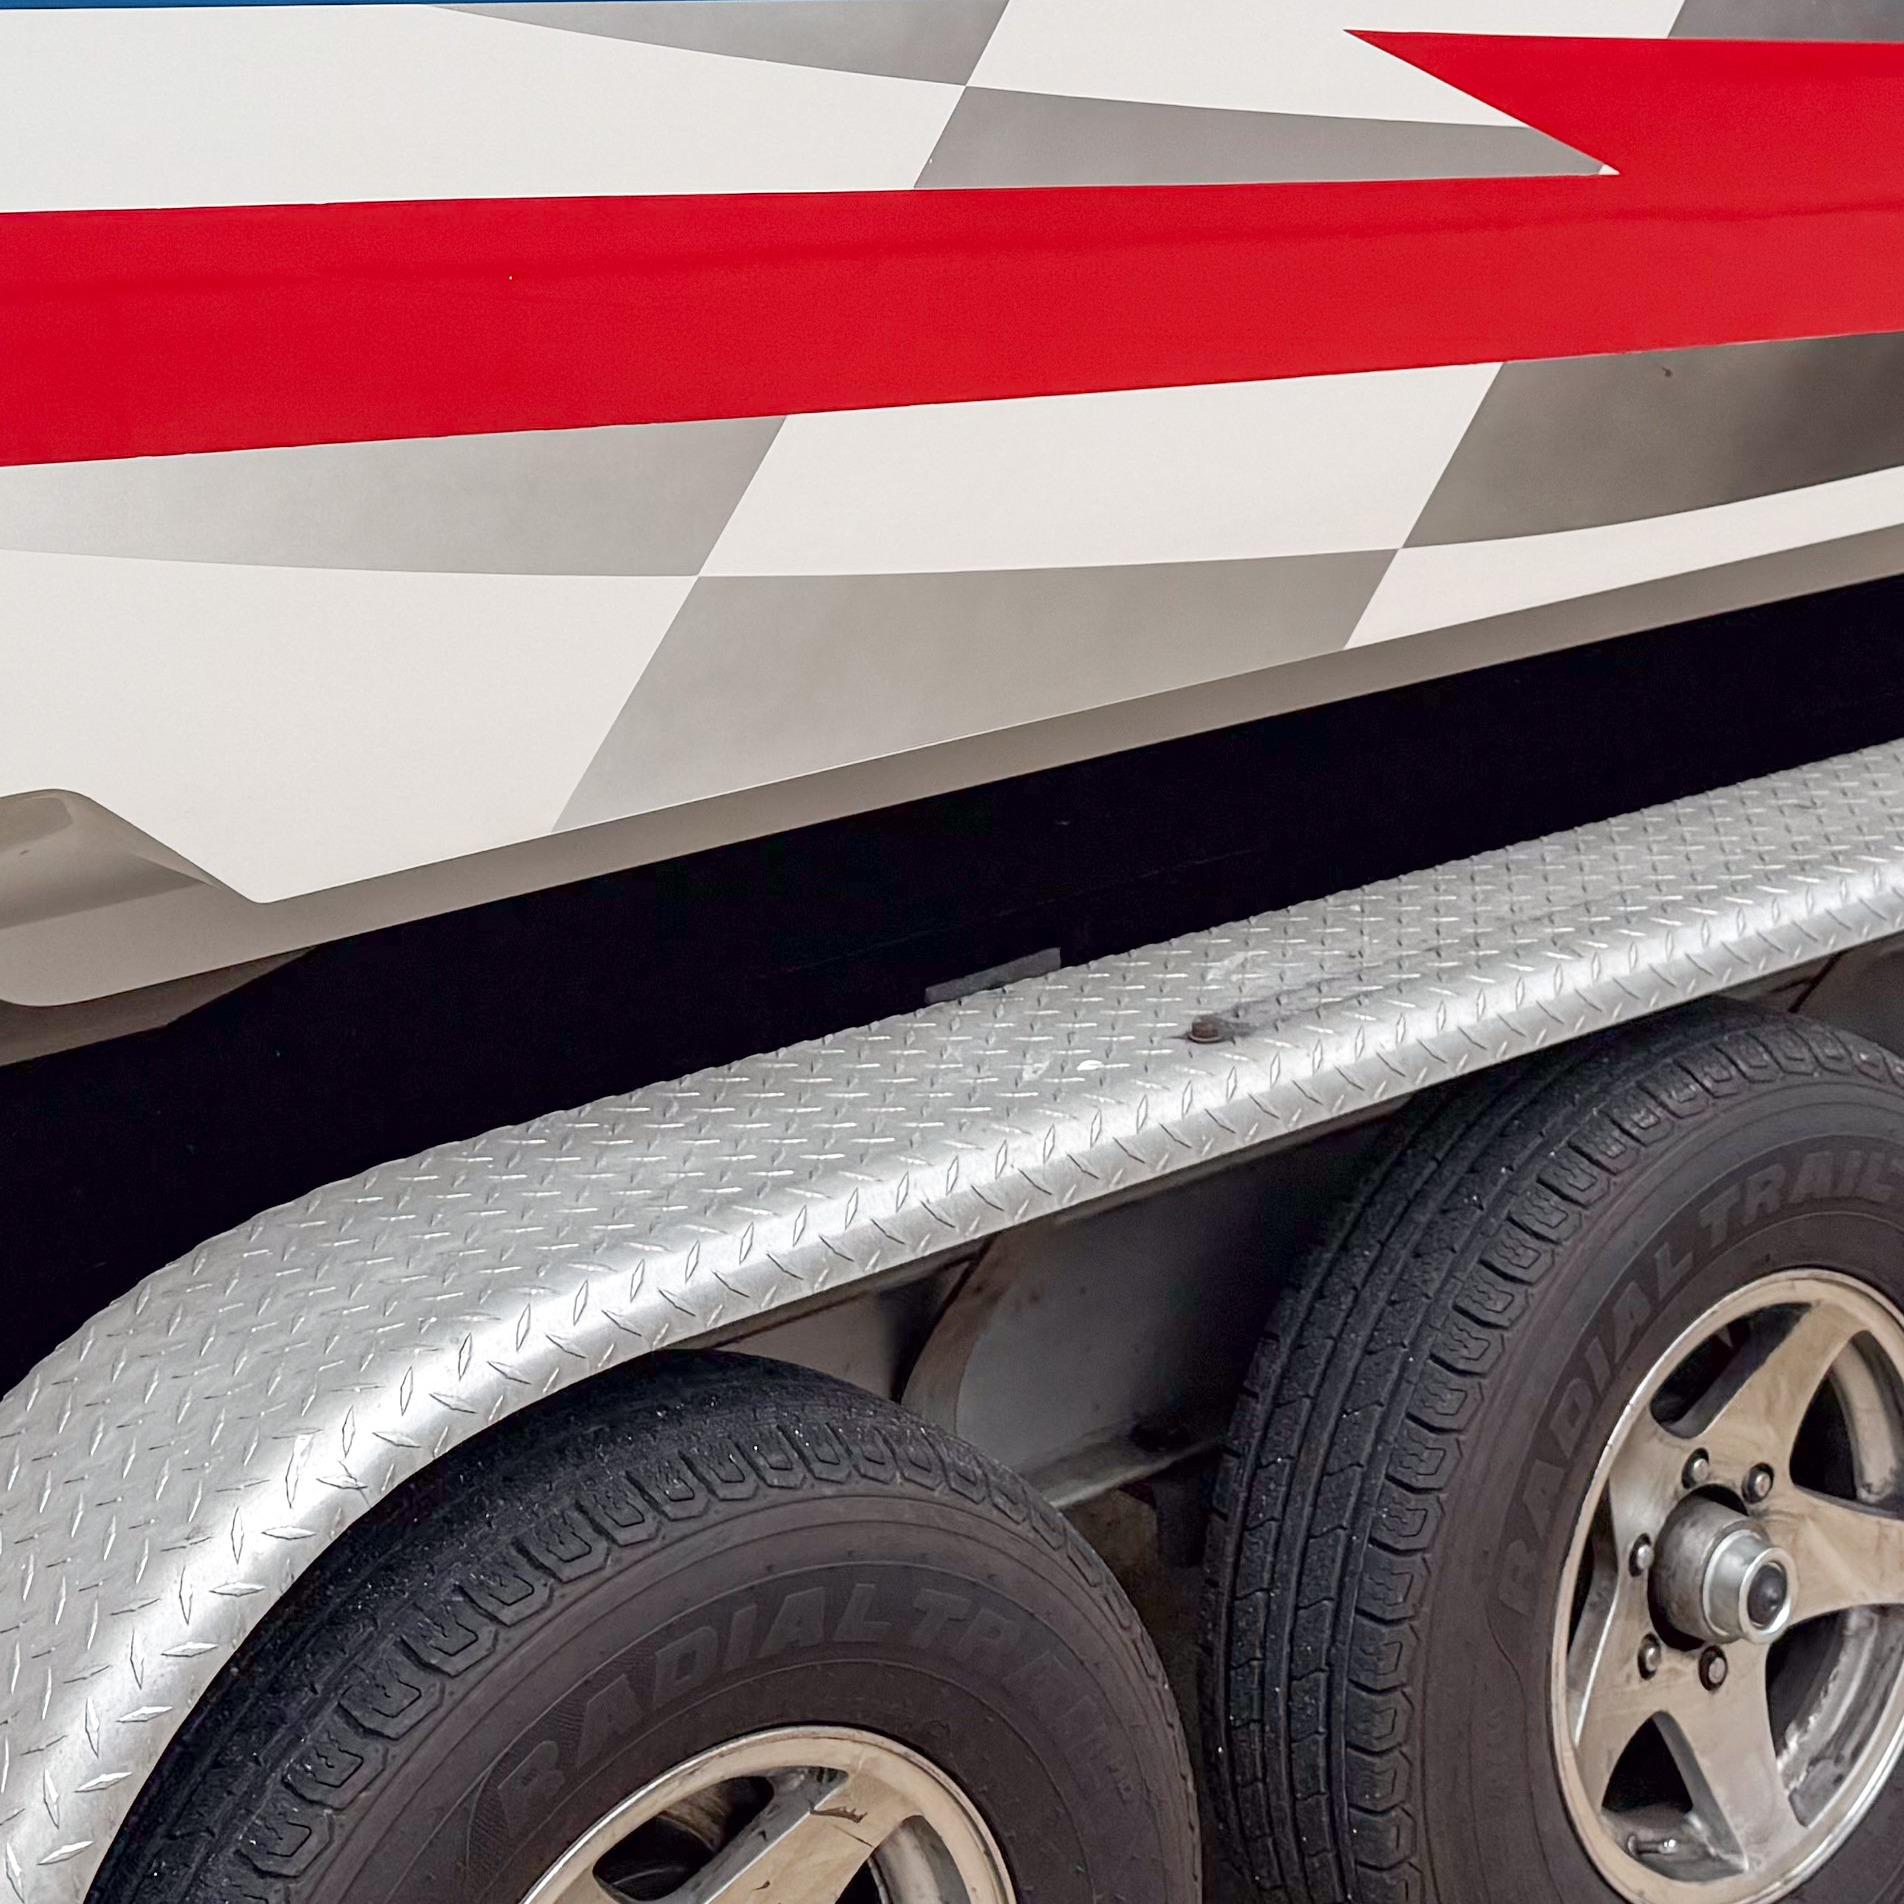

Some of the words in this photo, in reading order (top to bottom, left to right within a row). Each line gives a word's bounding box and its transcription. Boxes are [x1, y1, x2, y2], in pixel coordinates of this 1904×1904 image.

[1499, 1246, 1694, 1616] RADIAL
[1699, 1149, 1895, 1248] TRAIL
[497, 1582, 893, 1841] RADIAL
